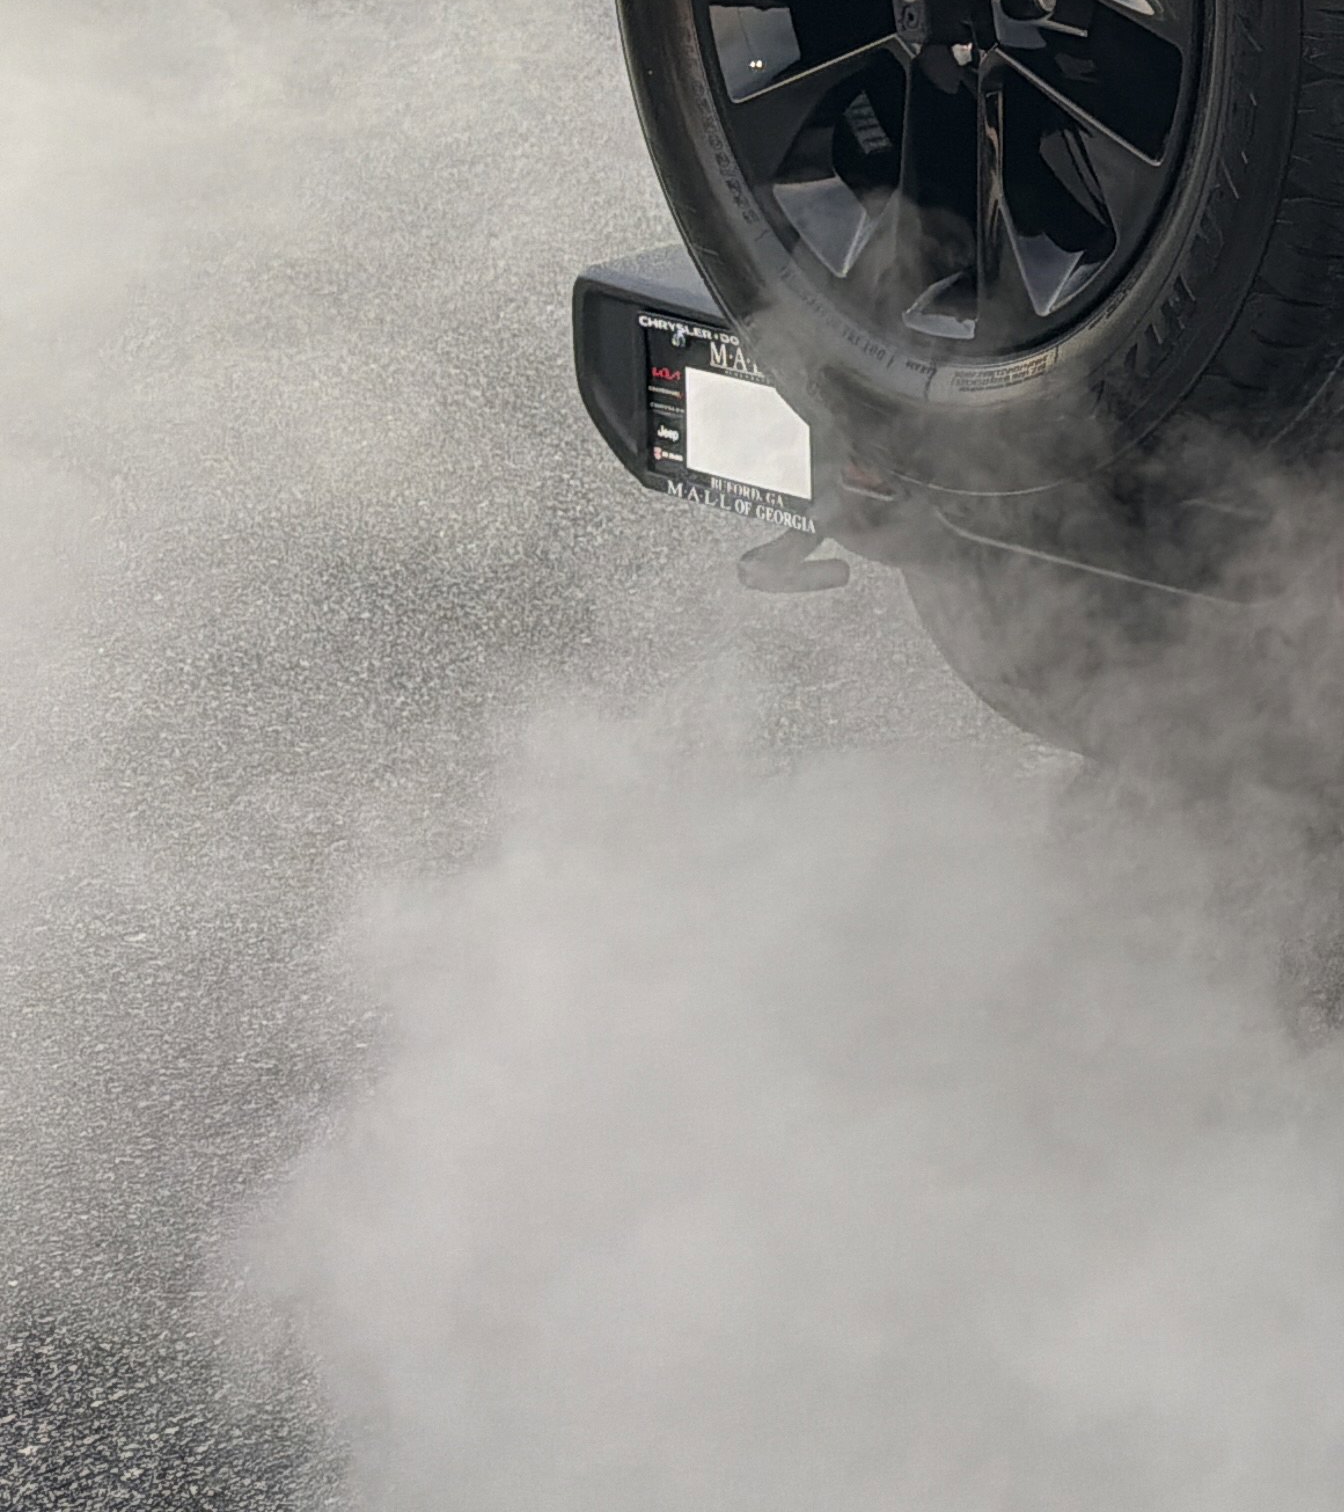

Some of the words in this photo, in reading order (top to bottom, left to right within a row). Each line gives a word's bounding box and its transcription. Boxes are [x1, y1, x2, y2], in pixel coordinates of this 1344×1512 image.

[638, 315, 712, 341] CHRYSLER
[766, 491, 784, 508] GA
[734, 499, 752, 517] OF
[756, 504, 816, 534] GEORGIA
